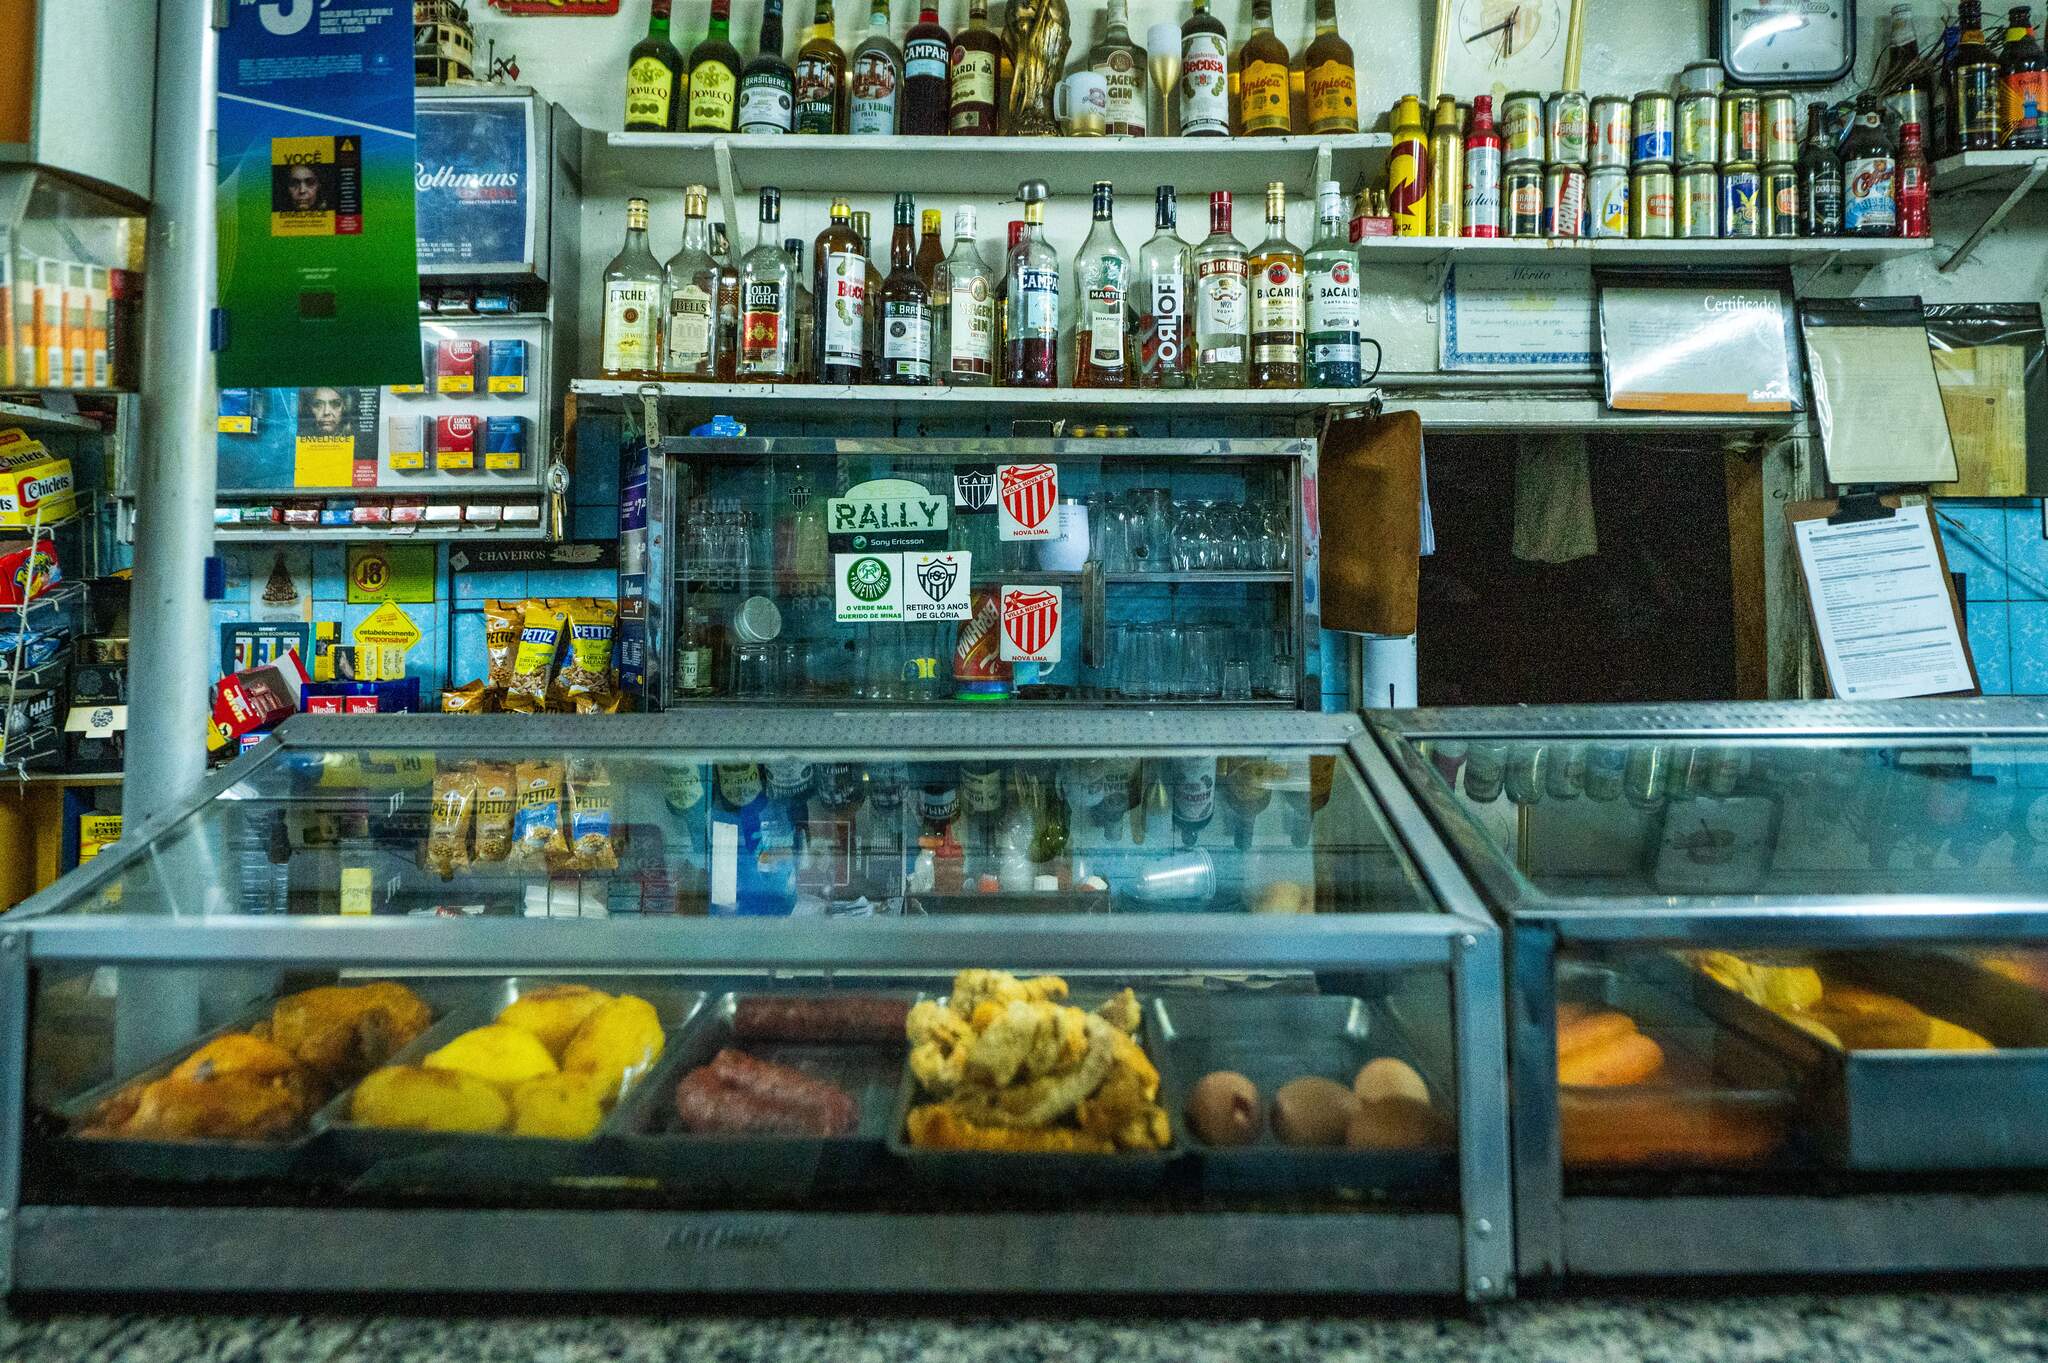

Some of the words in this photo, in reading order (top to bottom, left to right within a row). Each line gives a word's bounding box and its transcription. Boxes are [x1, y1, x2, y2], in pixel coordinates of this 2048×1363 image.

[903, 45, 949, 62] CAMPARI
[745, 74, 786, 87] BRASILBERG
[628, 87, 667, 98] DOMECQ
[692, 89, 732, 103] DOMECQ
[1108, 87, 1133, 99] GIN
[806, 102, 832, 113] VERDE
[869, 102, 892, 113] VERDE
[284, 150, 323, 165] VOCÊ
[1201, 261, 1247, 275] SMIRNOFF
[1020, 273, 1058, 293] CAMPA
[752, 285, 772, 295] OLD
[746, 293, 778, 305] EIGHT
[1704, 295, 1777, 313] Certificado
[1157, 275, 1178, 362] ORLOFF
[454, 416, 472, 424] LUCKY
[453, 423, 472, 431] STRIKE
[300, 434, 351, 443] ENVELHECE
[28, 475, 70, 500] Chiclets
[962, 477, 989, 485] CAM
[1004, 483, 1022, 494] VILLA
[1022, 477, 1039, 487] NOVA
[835, 500, 940, 530] RALLY
[870, 538, 890, 547] Sony
[891, 537, 924, 546] Ericsson
[479, 550, 546, 562] CHAVEIROS
[363, 562, 382, 585] 18
[850, 575, 889, 599] PALMEIRINHAS
[936, 603, 946, 611] 93
[946, 602, 969, 610] ANOS
[1006, 609, 1023, 618] VILLA
[1024, 604, 1041, 612] NOVA
[928, 611, 960, 619] GLÓRIA
[359, 629, 415, 637] estabelecimento
[486, 631, 515, 644] PETTIZ
[521, 628, 555, 643] PETTIZ
[574, 625, 613, 639] PETTIZ
[365, 635, 409, 645] responsável
[312, 705, 336, 713] Winston
[352, 705, 377, 713] Winston
[522, 787, 555, 805] PETTIZ
[575, 795, 609, 809] PETTIZ
[479, 800, 513, 814] PETTIZ
